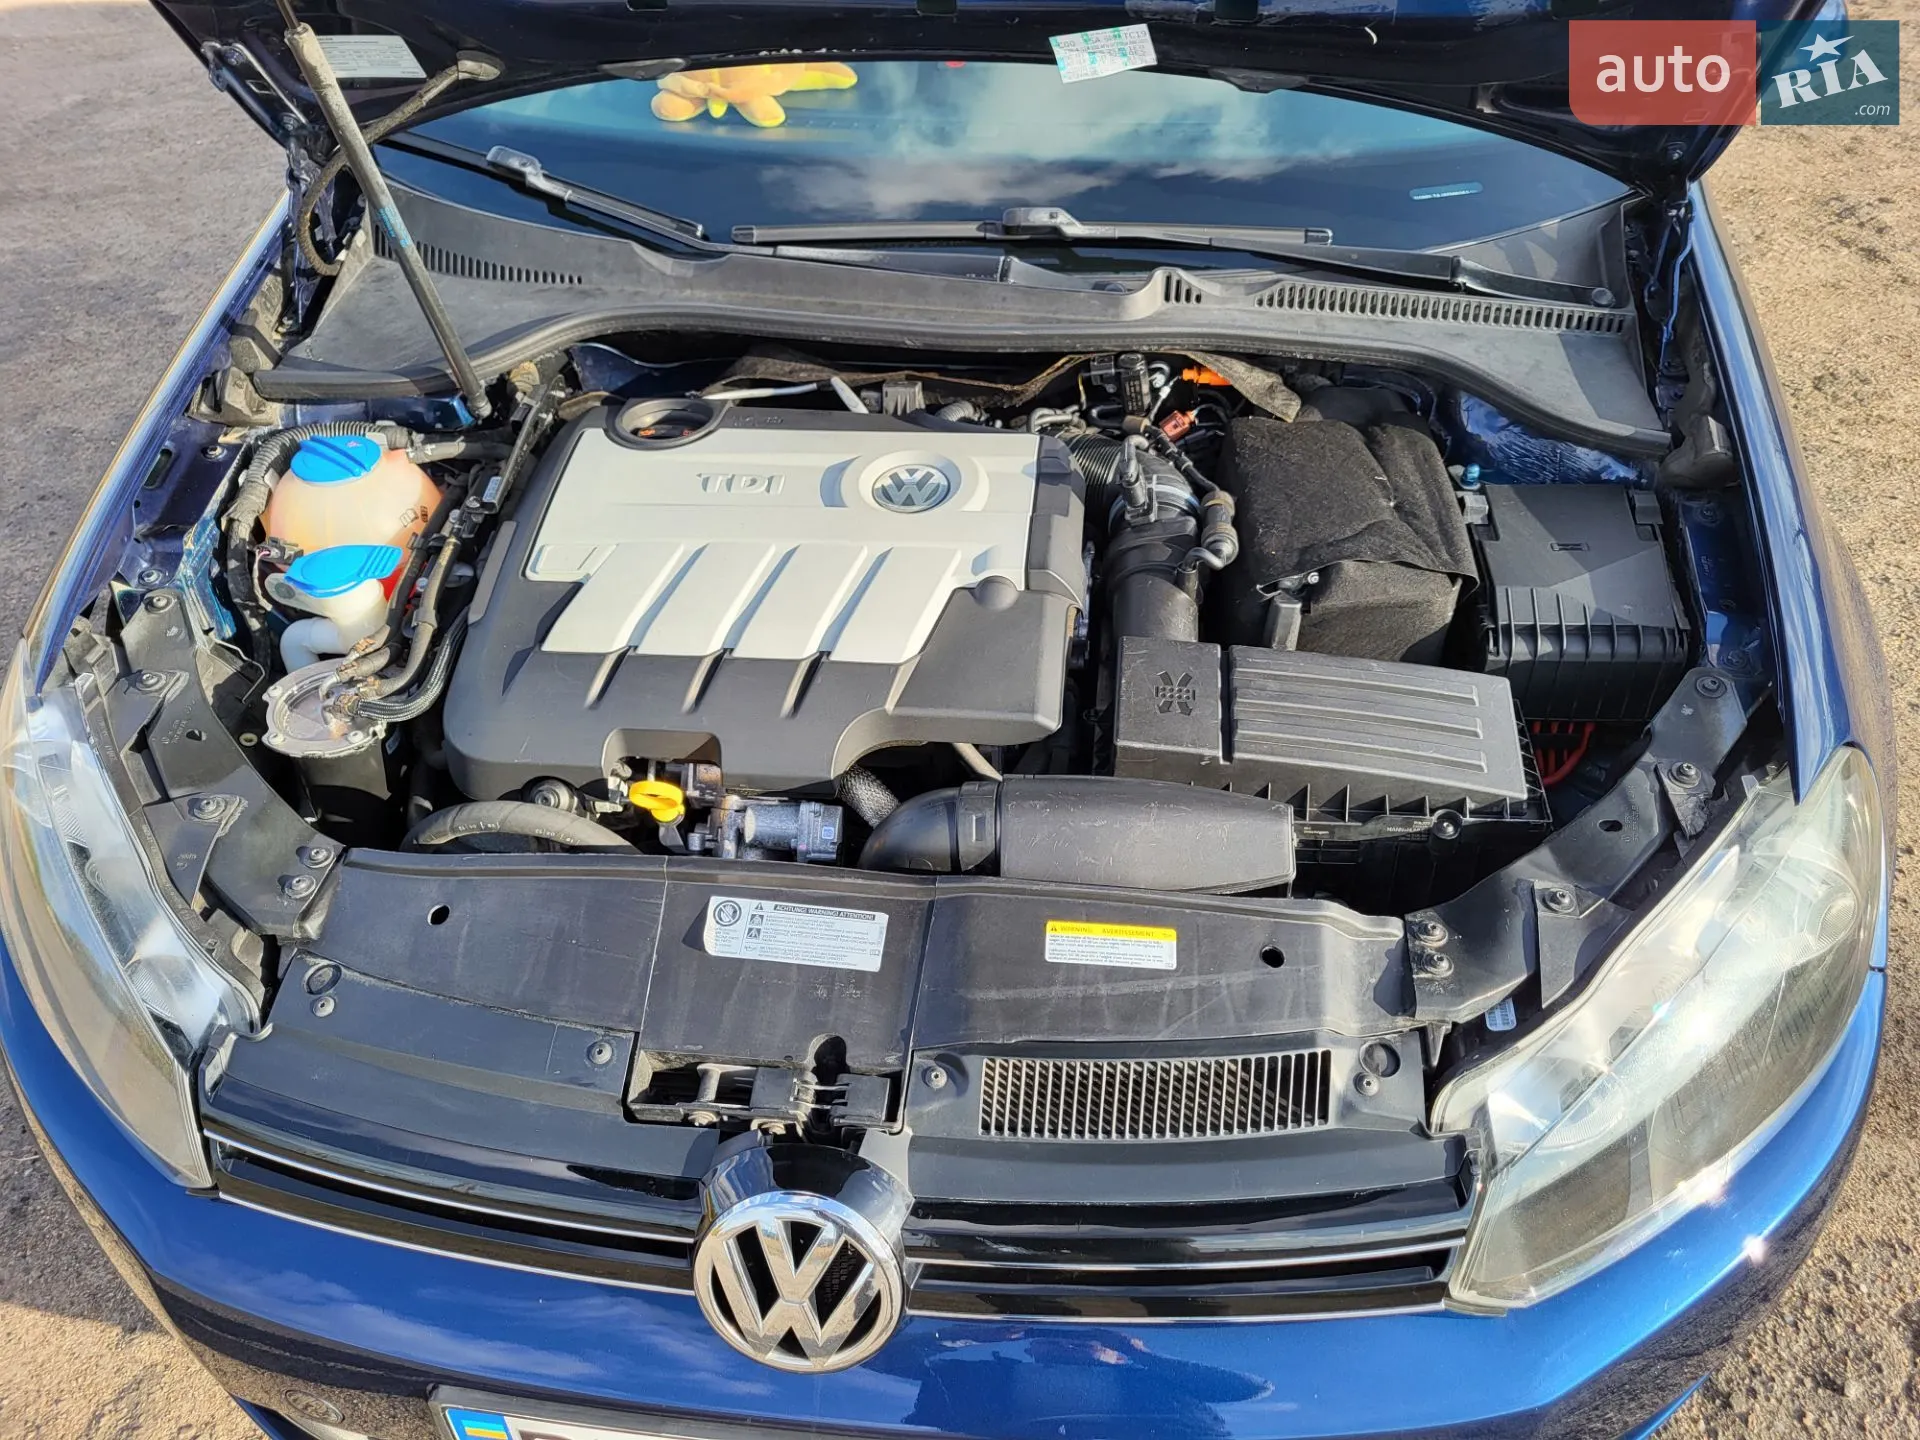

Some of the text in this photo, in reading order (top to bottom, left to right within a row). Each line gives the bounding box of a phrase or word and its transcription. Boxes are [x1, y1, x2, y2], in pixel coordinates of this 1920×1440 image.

[697, 472, 786, 496] TDI
[808, 908, 839, 917] WARNING!
[839, 911, 874, 921] ATTENTION!
[1102, 928, 1155, 937] AVERTISSEMENT
